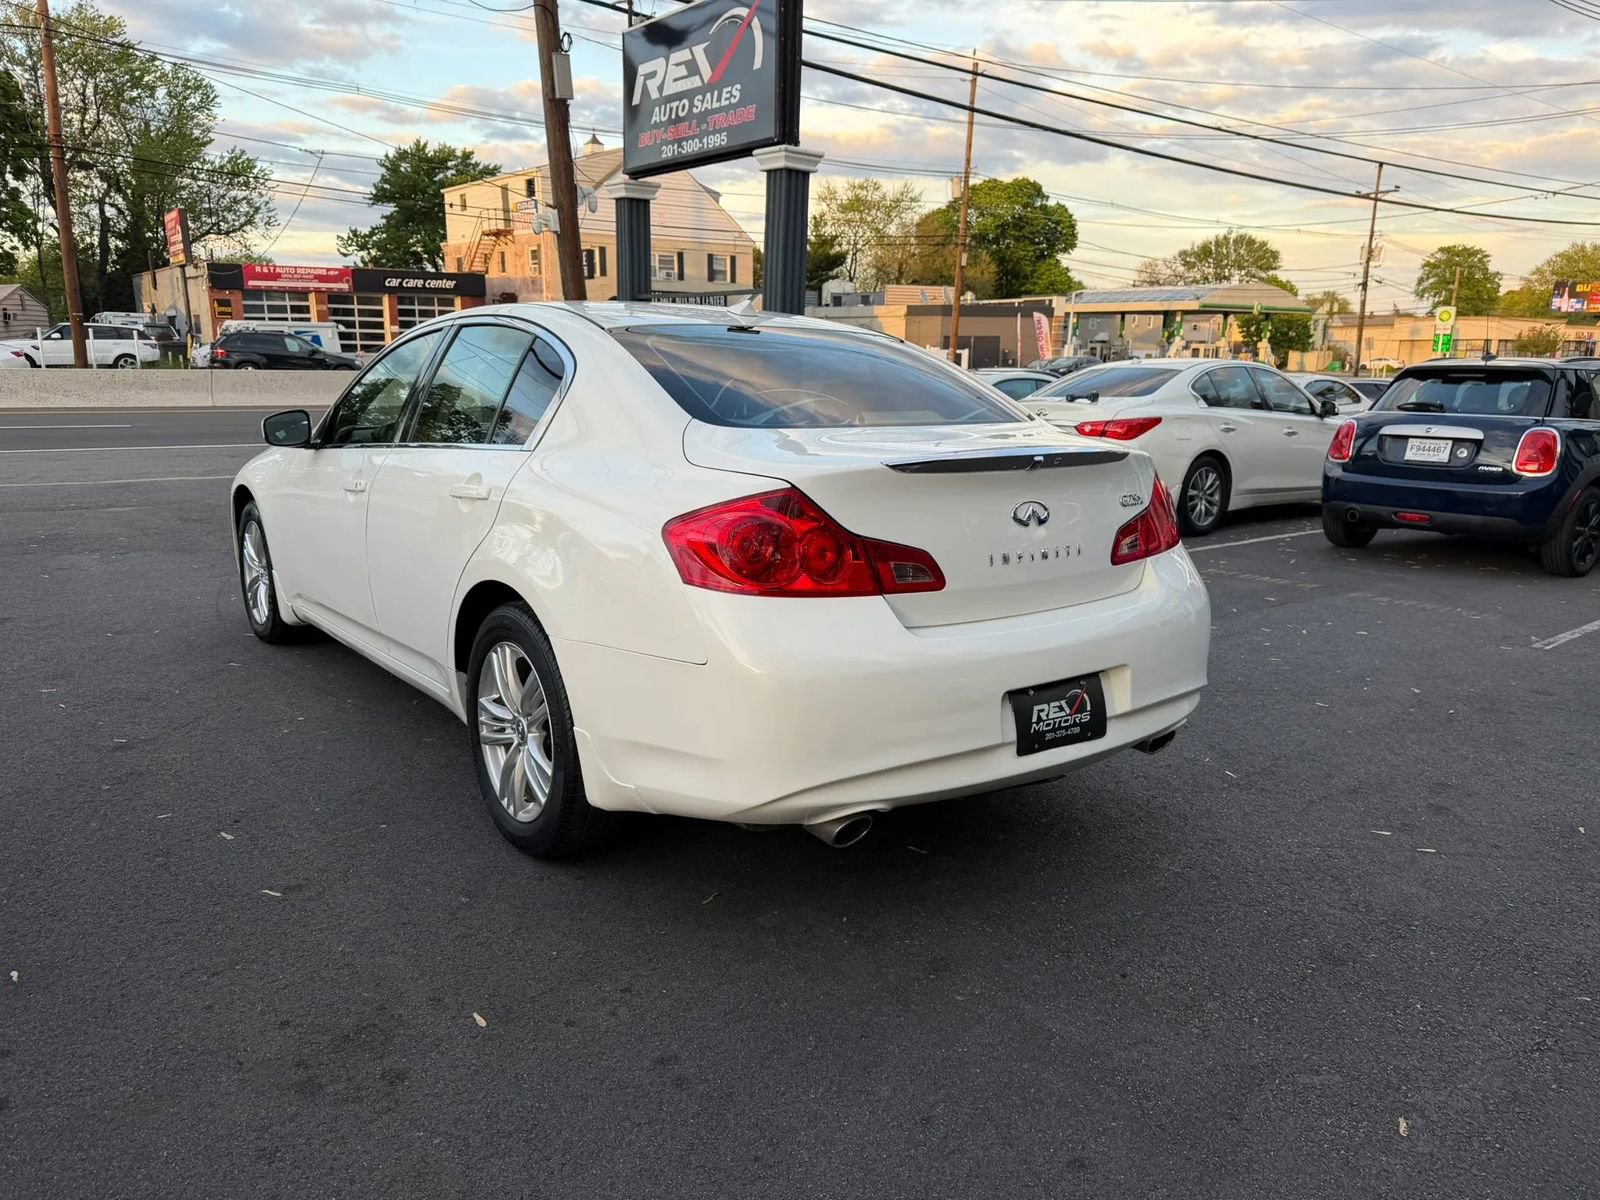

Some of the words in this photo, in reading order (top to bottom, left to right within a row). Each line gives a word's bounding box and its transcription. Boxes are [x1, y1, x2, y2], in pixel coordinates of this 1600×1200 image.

[651, 98, 689, 124] AUTO
[692, 83, 741, 114] SALES
[707, 104, 757, 131] TRADE
[661, 131, 728, 158] 201-300-1995
[275, 267, 297, 275] AUTO
[297, 267, 328, 276] REPAIRS
[385, 278, 401, 287] car
[402, 279, 424, 288] care
[425, 279, 456, 289] center
[1409, 443, 1448, 455] F944467
[989, 543, 1081, 568] INFINITI
[1032, 694, 1078, 723] REV
[1030, 711, 1091, 734] MOTORS
